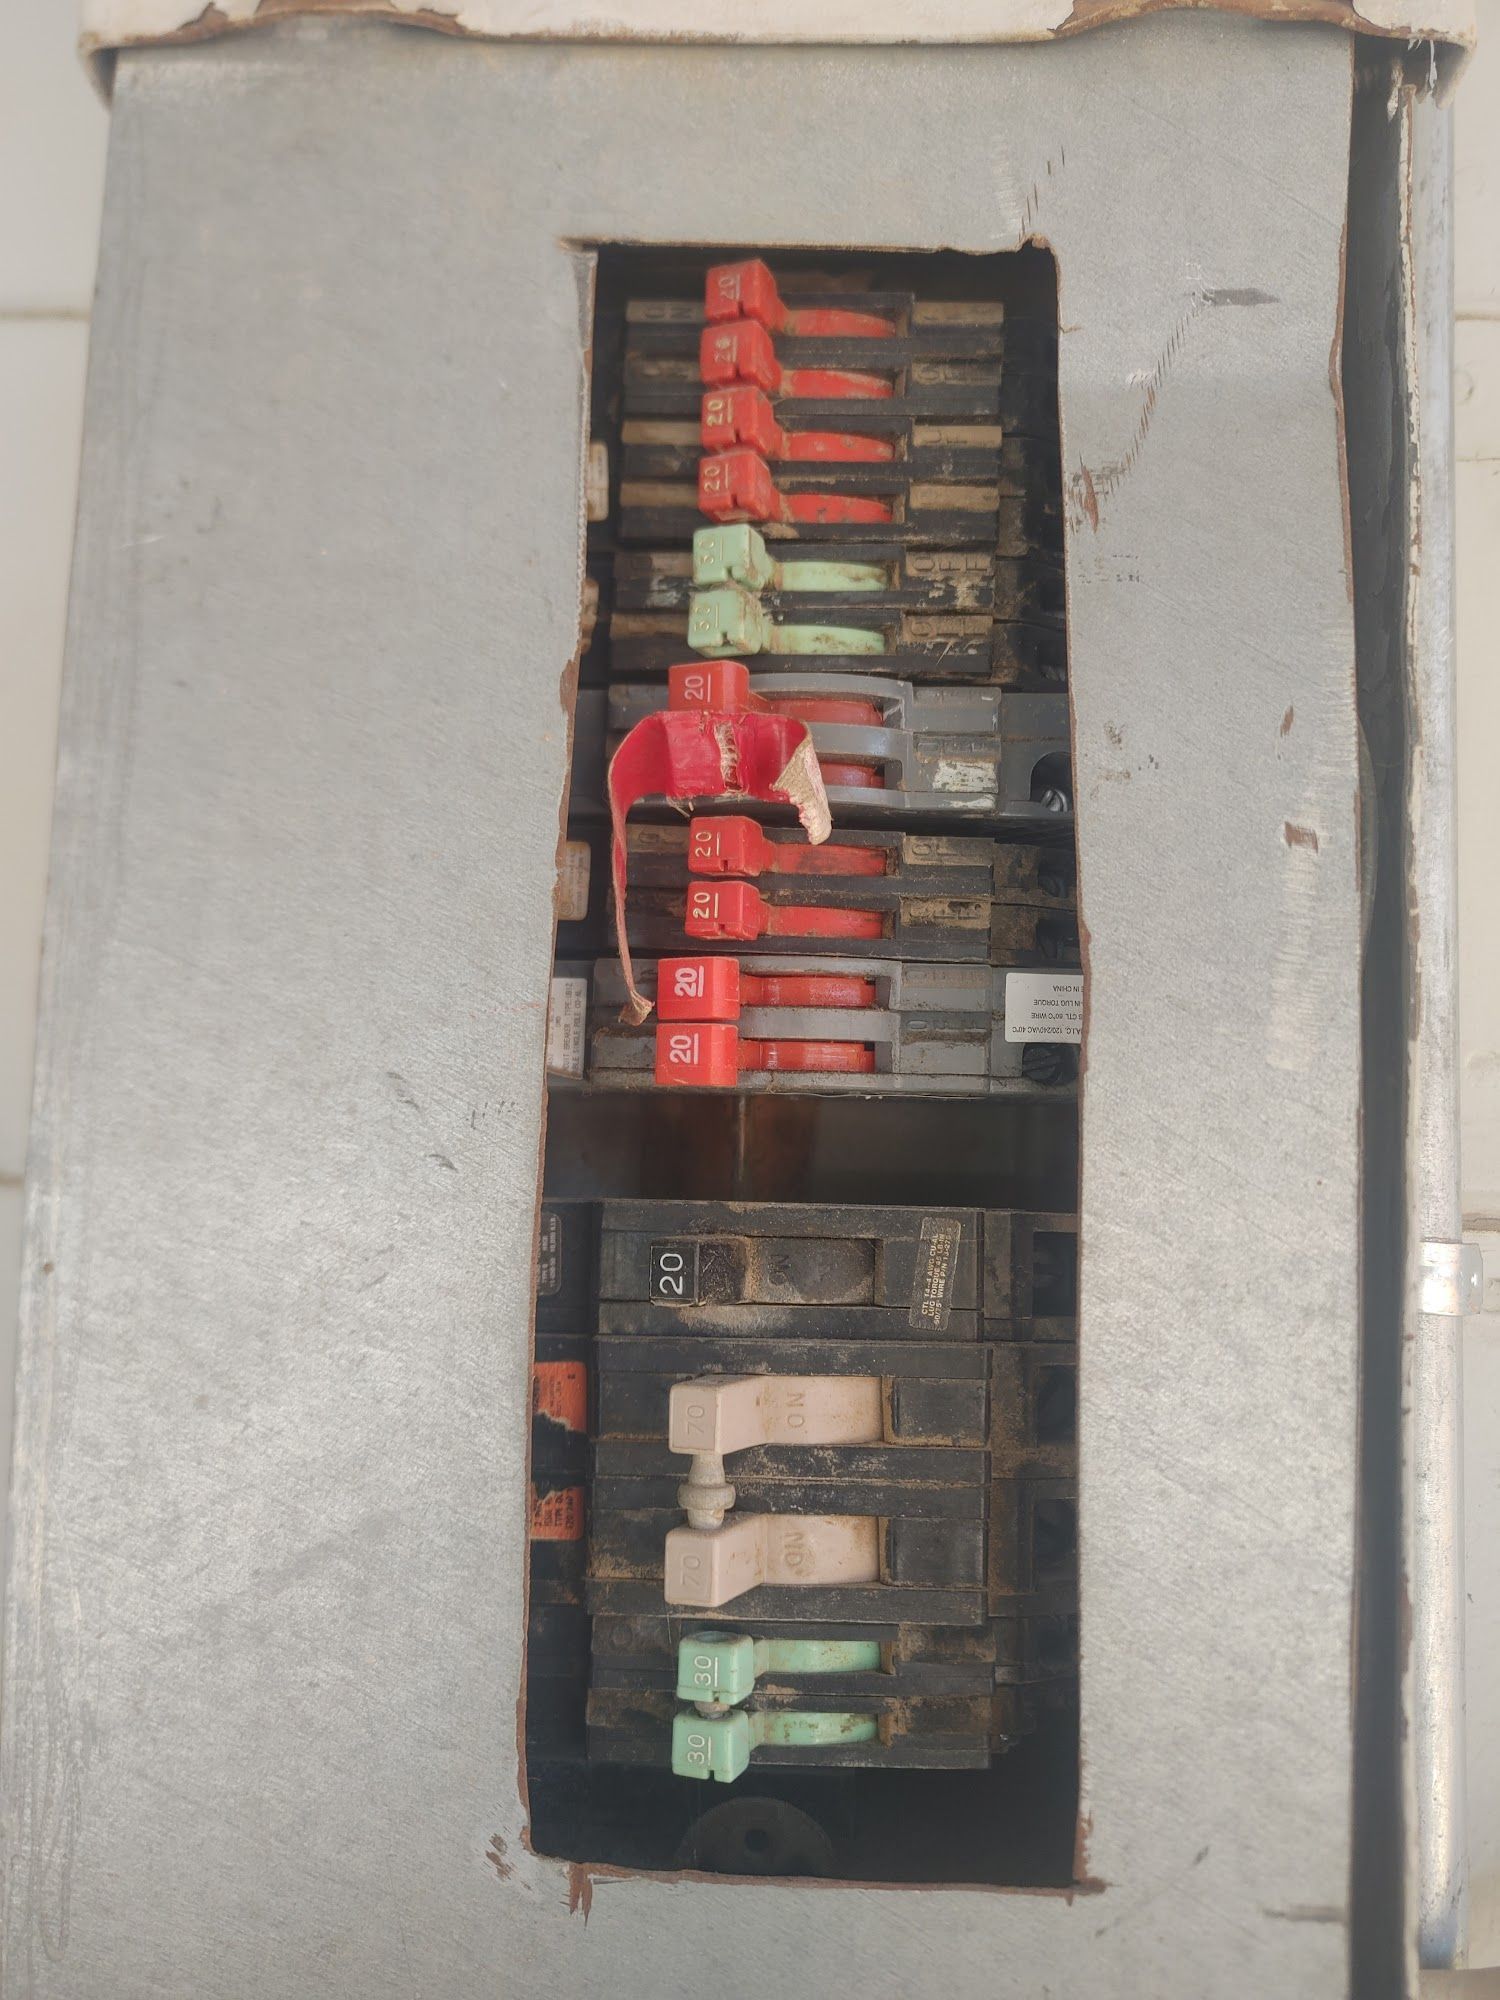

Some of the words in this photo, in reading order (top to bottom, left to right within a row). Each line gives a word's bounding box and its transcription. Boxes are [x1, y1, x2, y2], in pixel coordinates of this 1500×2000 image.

[718, 276, 735, 301] 20
[706, 399, 724, 426] 20
[703, 466, 721, 491] 20
[684, 674, 704, 701] 20
[694, 831, 712, 857] 20
[692, 892, 711, 919] 20
[674, 967, 698, 997] 20
[669, 1035, 692, 1064] 20
[659, 1253, 683, 1295] 20
[921, 1301, 929, 1315] CTL
[926, 1258, 935, 1276] AWG
[931, 1267, 940, 1298] TORQUE
[937, 1279, 946, 1297] WIRE
[687, 1405, 705, 1434] 70
[786, 1391, 805, 1428] ON
[784, 1531, 805, 1567] ON
[681, 1555, 701, 1586] 70
[694, 1655, 712, 1687] 30
[687, 1734, 705, 1765] 30
